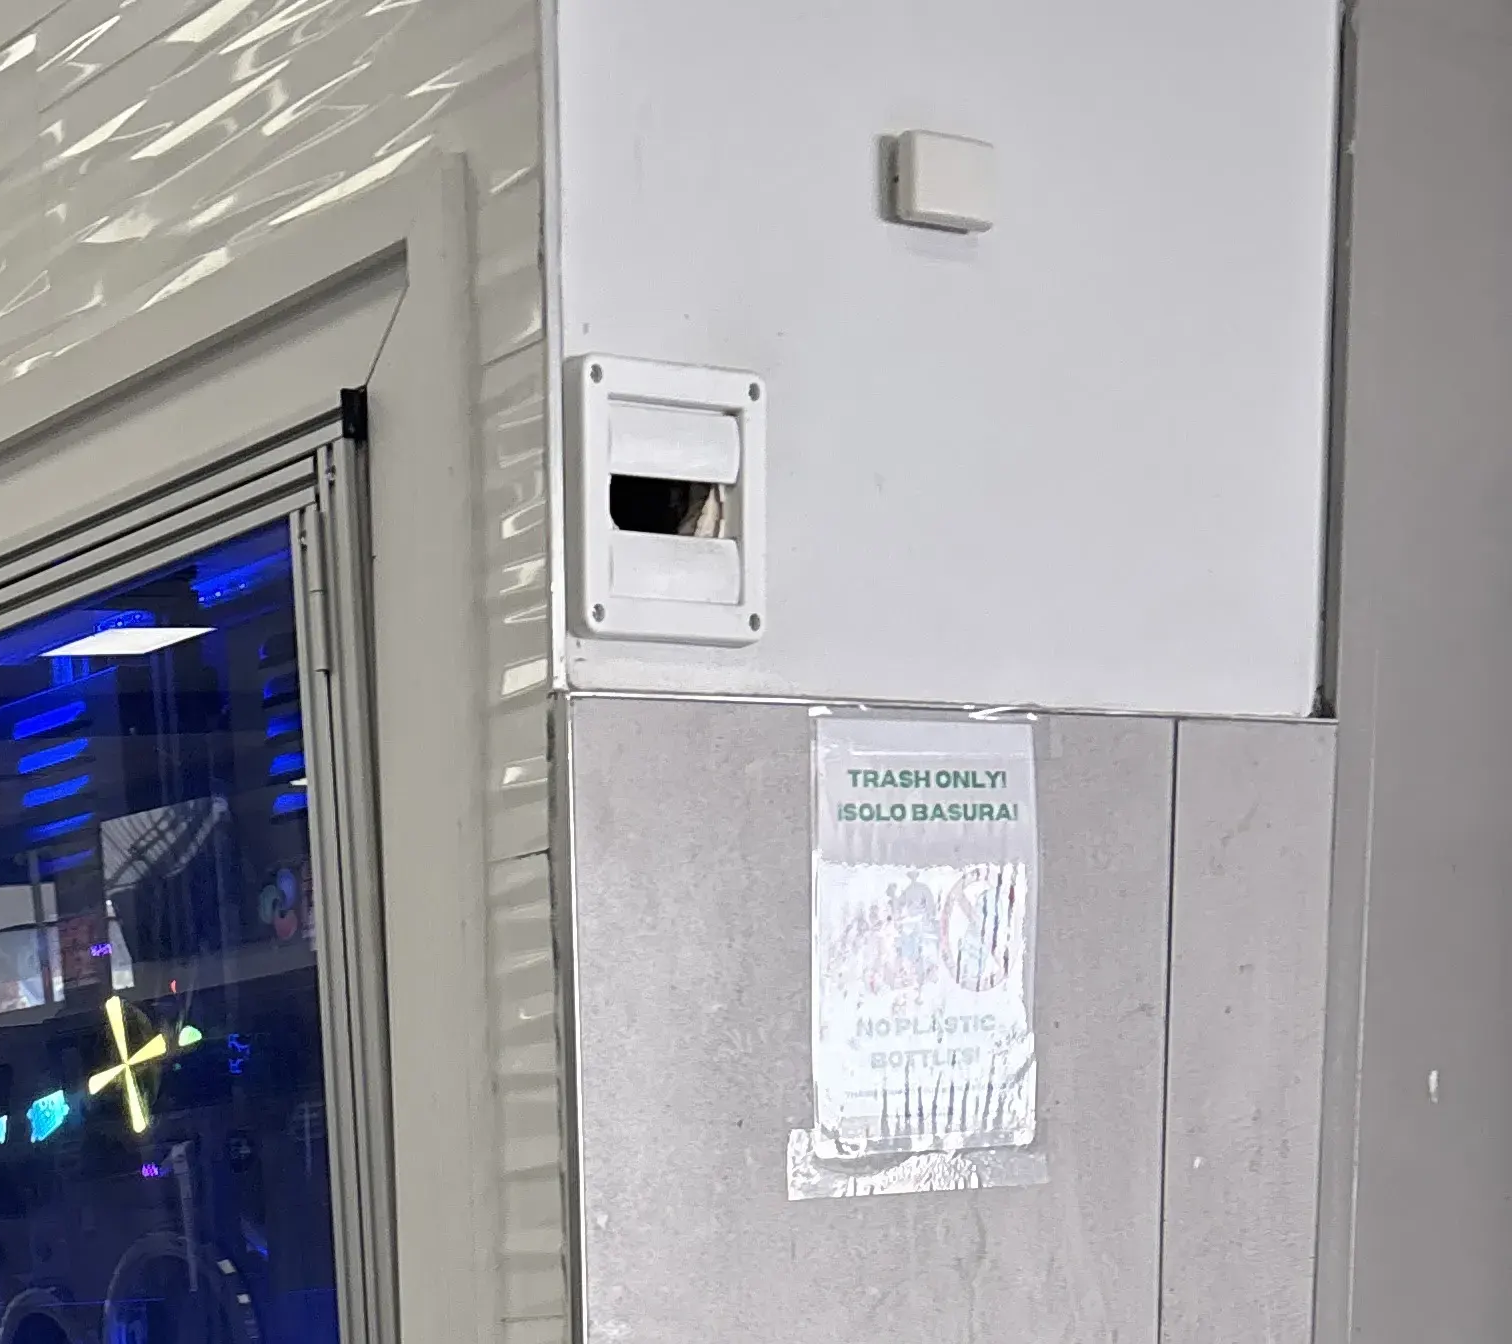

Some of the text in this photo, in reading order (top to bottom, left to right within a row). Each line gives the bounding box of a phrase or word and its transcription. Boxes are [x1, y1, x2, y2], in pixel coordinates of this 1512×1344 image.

[847, 769, 1008, 789] TRASH ONLY!
[912, 802, 1019, 822] BASURA!
[856, 1013, 997, 1038] NO PLASTIC
